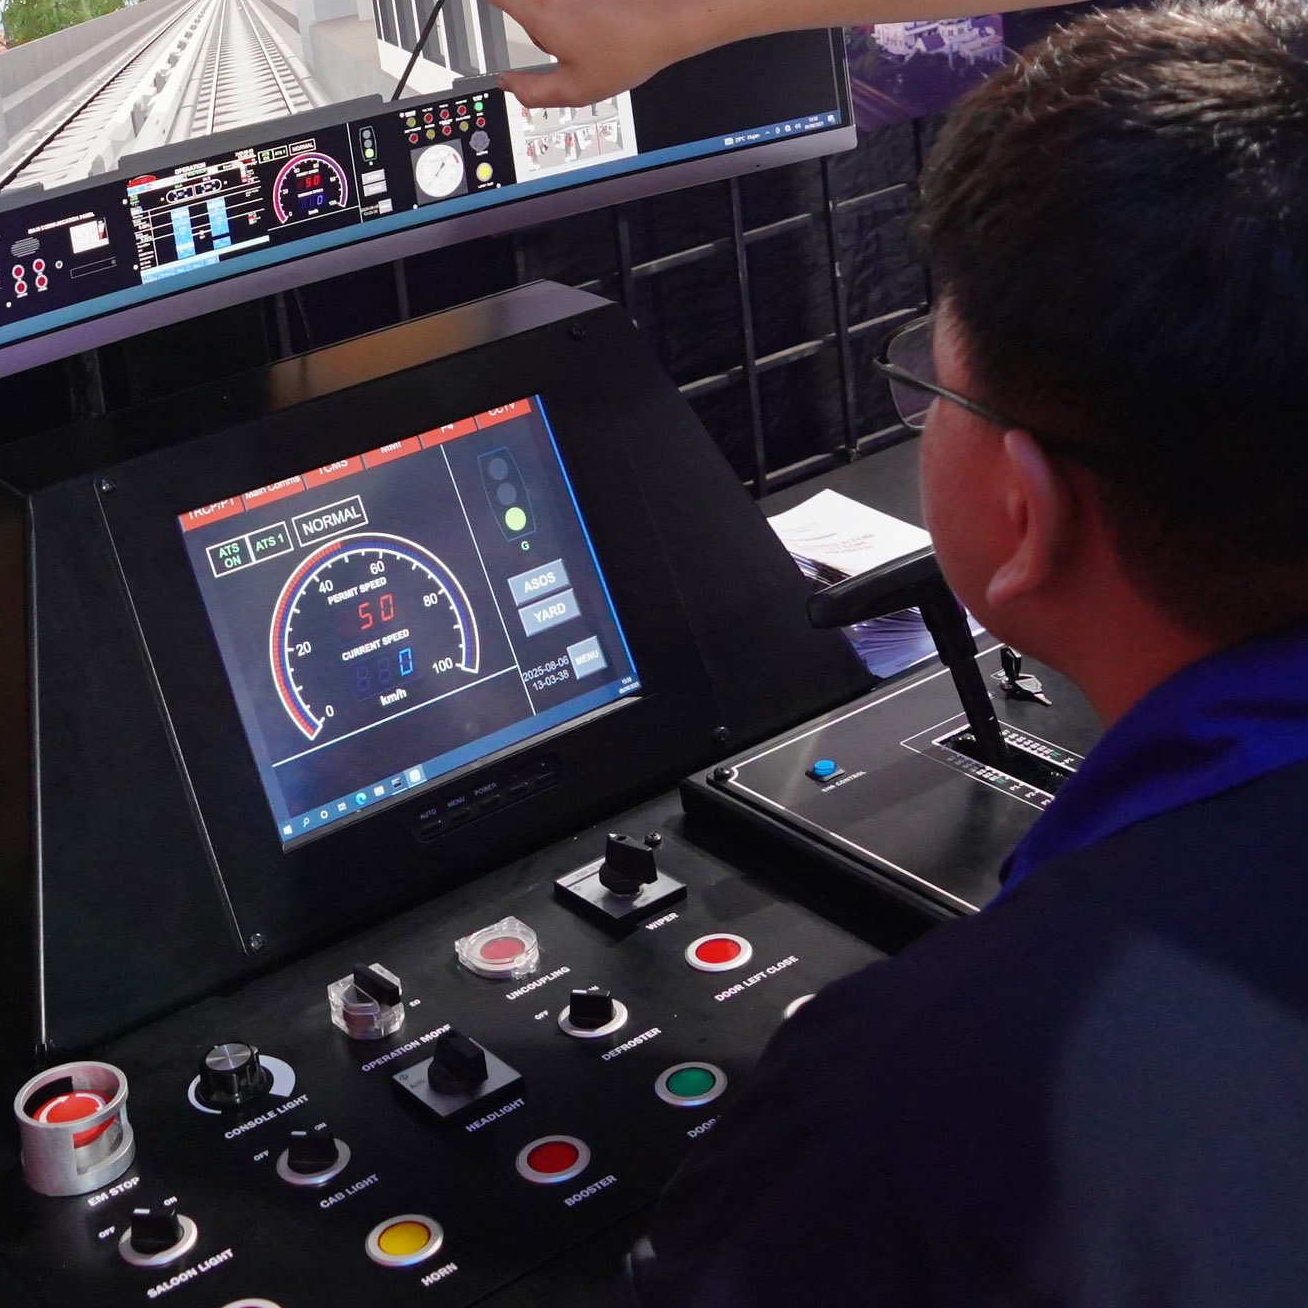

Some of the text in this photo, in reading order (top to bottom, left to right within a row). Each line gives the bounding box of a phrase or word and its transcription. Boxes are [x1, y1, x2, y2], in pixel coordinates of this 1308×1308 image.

[302, 505, 362, 536] NORMAL
[218, 542, 240, 558] ATS
[255, 533, 284, 552] ATS 1
[521, 541, 530, 551] G
[224, 554, 242, 569] ON
[370, 560, 385, 574] 60
[319, 579, 334, 593] 40
[327, 576, 387, 605] PERMIT SPEED
[524, 572, 556, 593] ASOS
[423, 593, 438, 607] 80
[358, 594, 394, 629] 50
[534, 603, 566, 623] YARD
[295, 641, 312, 656] 20
[342, 628, 410, 661] CURRENT SPEED
[398, 647, 414, 677] 0
[432, 657, 453, 674] 100
[575, 649, 599, 666] MENU
[522, 655, 570, 682] 2025-08-06
[532, 669, 570, 691] 13-03-38
[380, 688, 407, 706] km/h
[325, 705, 334, 717] 0
[474, 782, 498, 796] POWER
[447, 796, 466, 808] MENU
[420, 808, 437, 820] AUTO
[645, 911, 679, 931] WIPER
[505, 966, 572, 1000] UNCOUPLING
[714, 955, 799, 1002] DOOR LEFT CLOSE
[534, 1009, 549, 1021] OFF
[601, 1027, 662, 1061] DEFROSTER
[361, 1039, 421, 1072] OPERATION
[224, 1094, 310, 1140] CONSOLE LIGHT
[465, 1097, 525, 1132] HEADLIGHT
[314, 1122, 327, 1132] ON
[253, 1149, 270, 1162] OFF
[87, 1176, 140, 1207] EM STOP
[163, 1195, 178, 1206] ON
[319, 1173, 379, 1209] CAB LIGHT
[564, 1174, 618, 1207] BOOSTER
[98, 1225, 116, 1239] OFF
[146, 1248, 234, 1299] SALOON LIGHT
[421, 1262, 458, 1287] HORN
